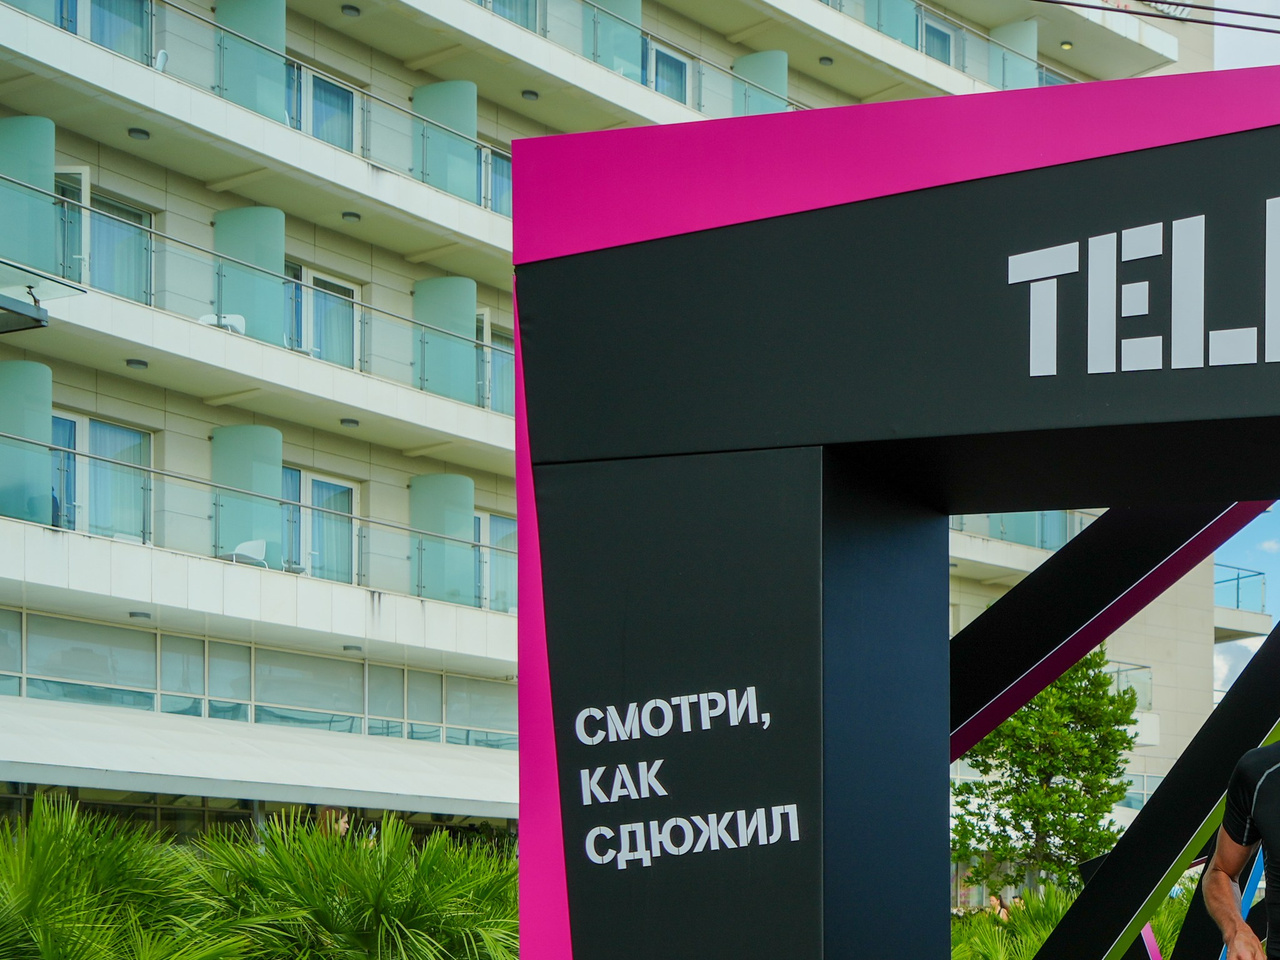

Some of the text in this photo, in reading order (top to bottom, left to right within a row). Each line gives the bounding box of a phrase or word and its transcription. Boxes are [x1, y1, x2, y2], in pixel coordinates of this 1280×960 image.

[575, 686, 771, 746] СМОТРИ,
[580, 759, 669, 806] КАК
[585, 803, 800, 870] СДЮЖИЛ
